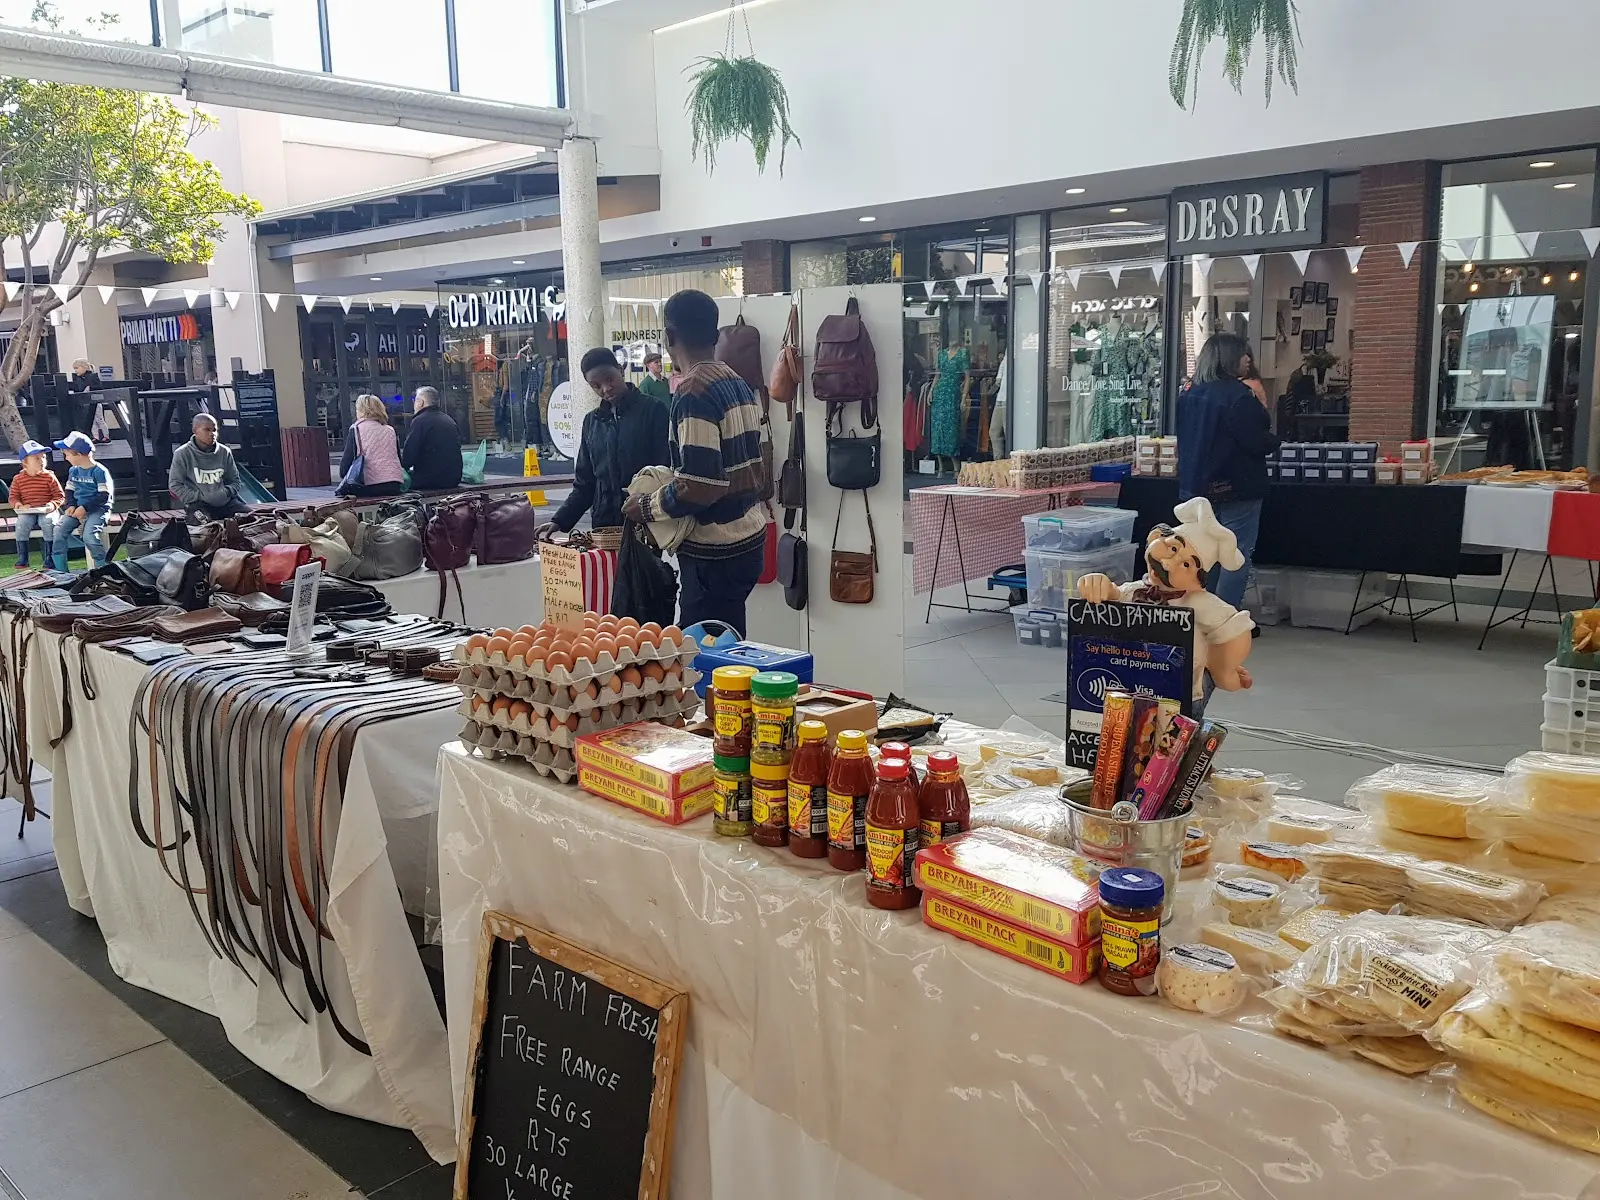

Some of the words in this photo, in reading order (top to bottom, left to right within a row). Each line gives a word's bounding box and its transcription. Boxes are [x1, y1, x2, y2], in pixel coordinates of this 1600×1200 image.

[1176, 187, 1314, 243] DESRAY
[448, 294, 479, 328] OLD
[483, 287, 538, 326] KHAKI
[120, 319, 147, 346] PRIMI
[147, 316, 178, 343] PIATTI
[1127, 373, 1143, 390] Live.
[554, 421, 571, 431] 50%
[544, 576, 554, 585] 30
[550, 568, 567, 577] EGGS
[546, 586, 558, 596] R75
[1069, 601, 1122, 627] CARD
[1126, 605, 1192, 631] PAYMENTS
[1085, 642, 1099, 654] Say
[1101, 644, 1120, 656] hello
[1122, 647, 1131, 656] to
[1132, 649, 1151, 660] easy
[1110, 656, 1128, 666] card
[1129, 659, 1170, 672] payments
[1134, 684, 1154, 695] Visa
[1077, 719, 1098, 728] Accepted
[1099, 725, 1109, 756] GOOD
[1110, 726, 1124, 759] BUENA
[582, 746, 613, 764] BREYANI
[615, 759, 635, 773] PACK
[1094, 758, 1105, 789] LUCK
[1186, 751, 1210, 787] ATTRACTS
[584, 772, 615, 790] BREYANI
[617, 784, 636, 798] PACK
[1104, 760, 1120, 796] SUERTE
[1173, 783, 1194, 812] MONEY
[928, 865, 978, 894] BREYANI
[982, 885, 1014, 907] PACK
[934, 902, 982, 929] BREYANI
[986, 922, 1017, 944] PACK
[1105, 947, 1129, 960] MASALA
[1114, 944, 1137, 954] PRAWN
[1371, 956, 1399, 978] Cocktail
[1399, 971, 1421, 989] Butter
[1420, 983, 1439, 998] Rotis
[508, 942, 588, 1016] FARM
[604, 993, 658, 1044] FRESH
[1400, 986, 1432, 1010] MINI
[500, 1014, 548, 1066] FREE
[561, 1048, 621, 1091] RANGE
[535, 1085, 592, 1129] EGGS
[485, 1135, 506, 1167] 30
[515, 1154, 573, 1200] LARGE
